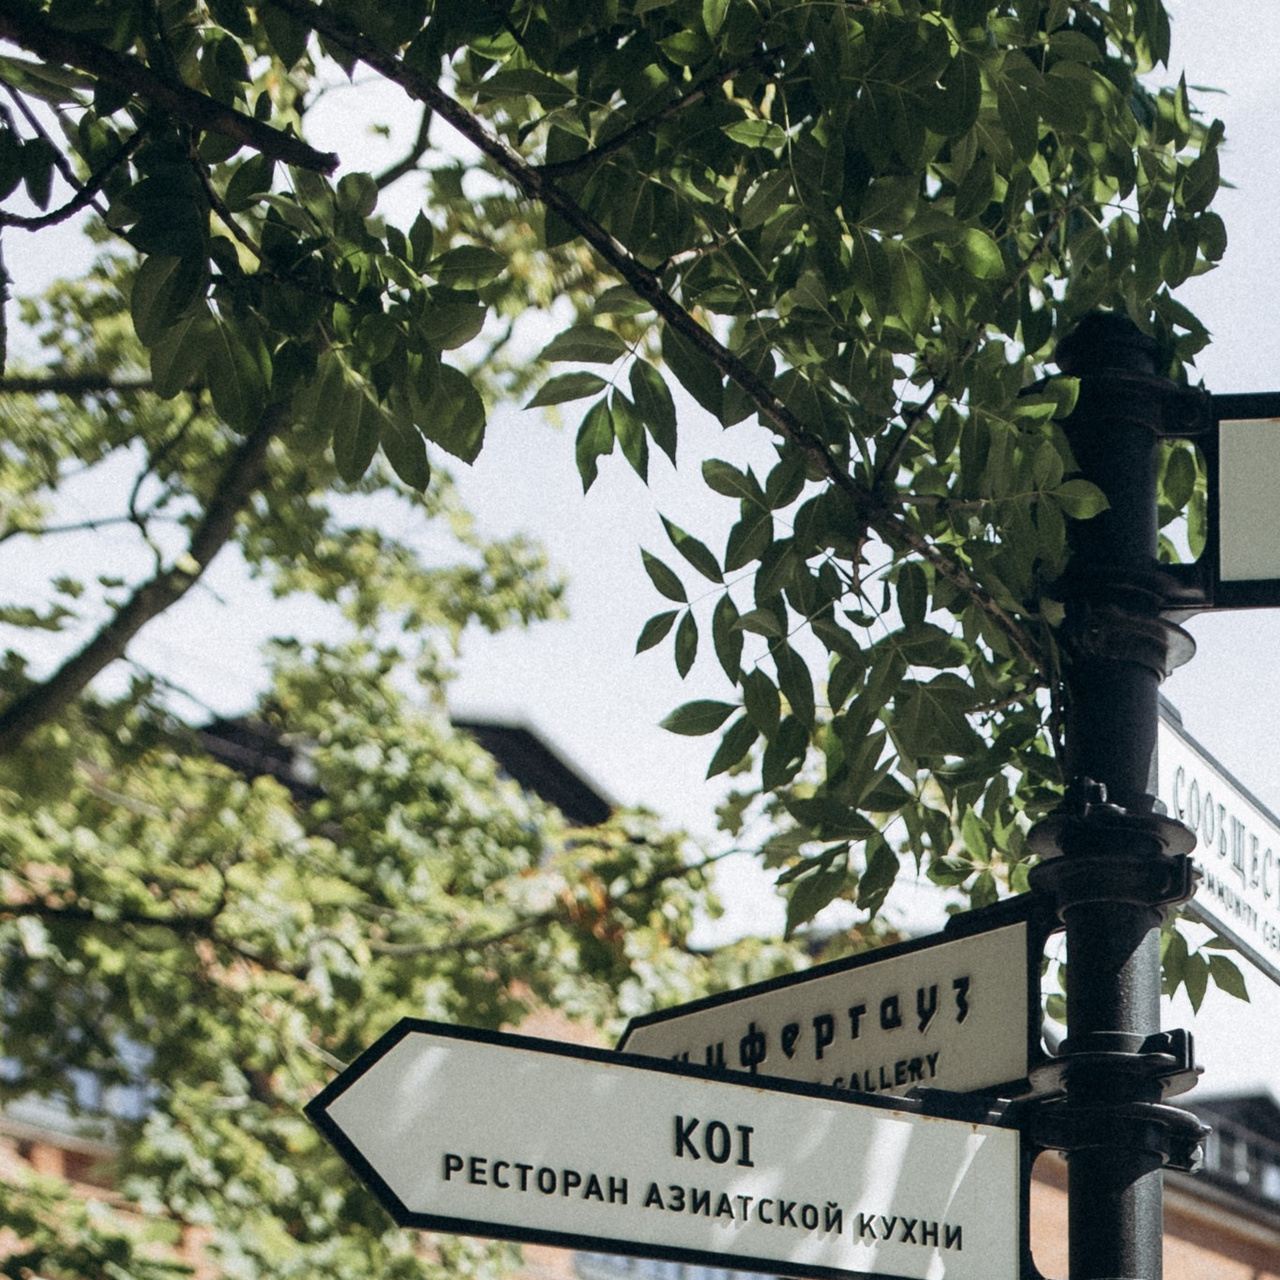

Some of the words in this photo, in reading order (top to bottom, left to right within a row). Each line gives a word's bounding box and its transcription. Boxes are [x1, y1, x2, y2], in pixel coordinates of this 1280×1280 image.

[671, 976, 971, 1074] ифергауз
[674, 1115, 755, 1168] KOI
[443, 1153, 629, 1206] РЕСТОРАН
[643, 1182, 844, 1236] АЗИАТСКОЙ
[859, 1213, 962, 1252] КУХНИ
